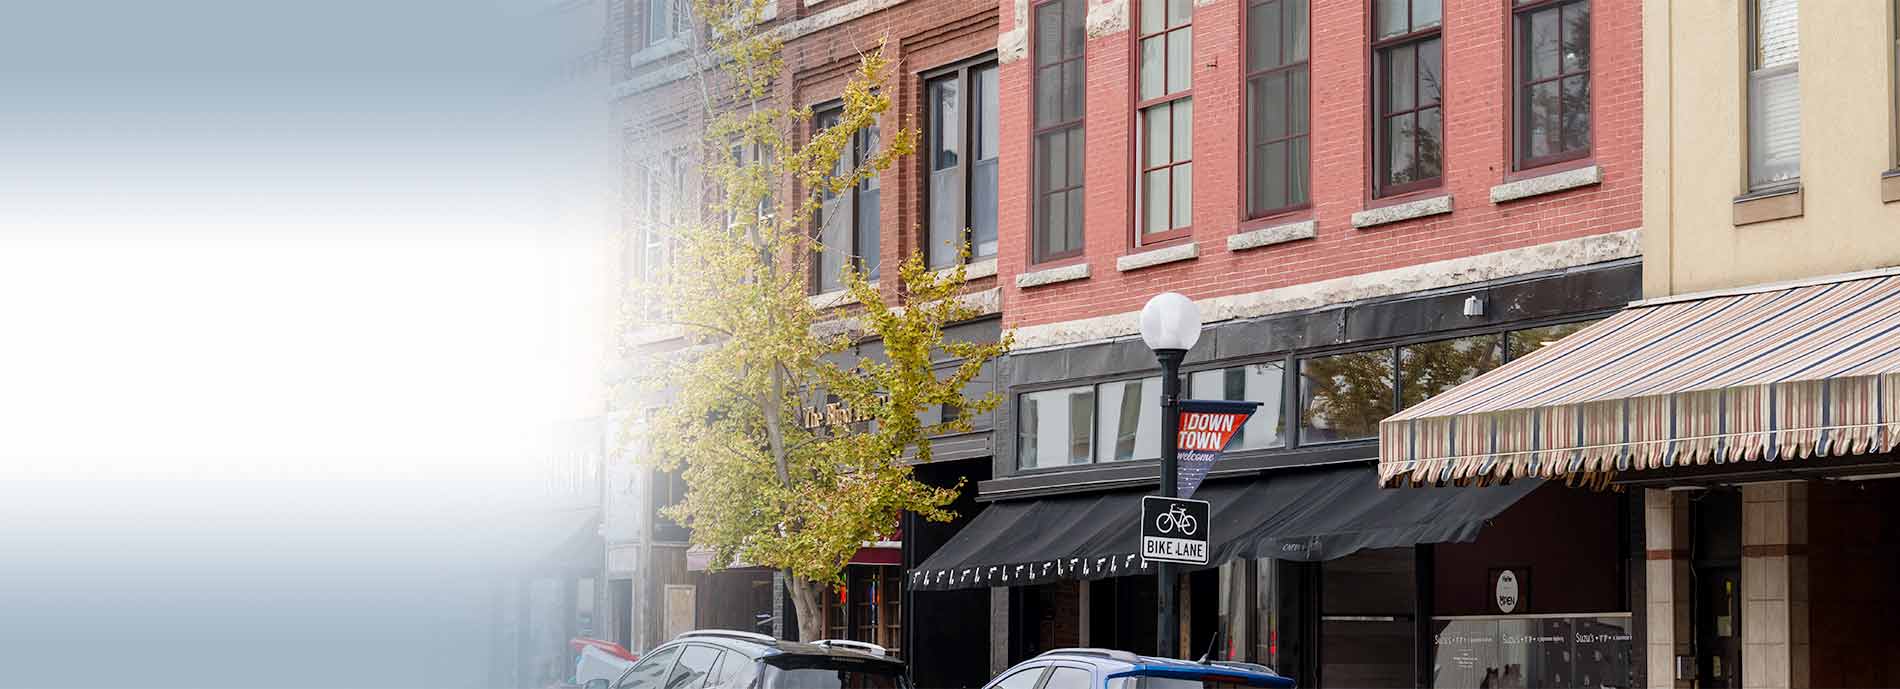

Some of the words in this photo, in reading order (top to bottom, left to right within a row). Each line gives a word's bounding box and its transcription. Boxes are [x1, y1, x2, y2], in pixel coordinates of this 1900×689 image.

[802, 406, 823, 428] The
[1188, 413, 1234, 432] DOWN
[1178, 431, 1222, 449] TOWN
[1177, 450, 1215, 461] welcome
[1147, 540, 1173, 555] BIKE
[1177, 542, 1203, 557] LANE
